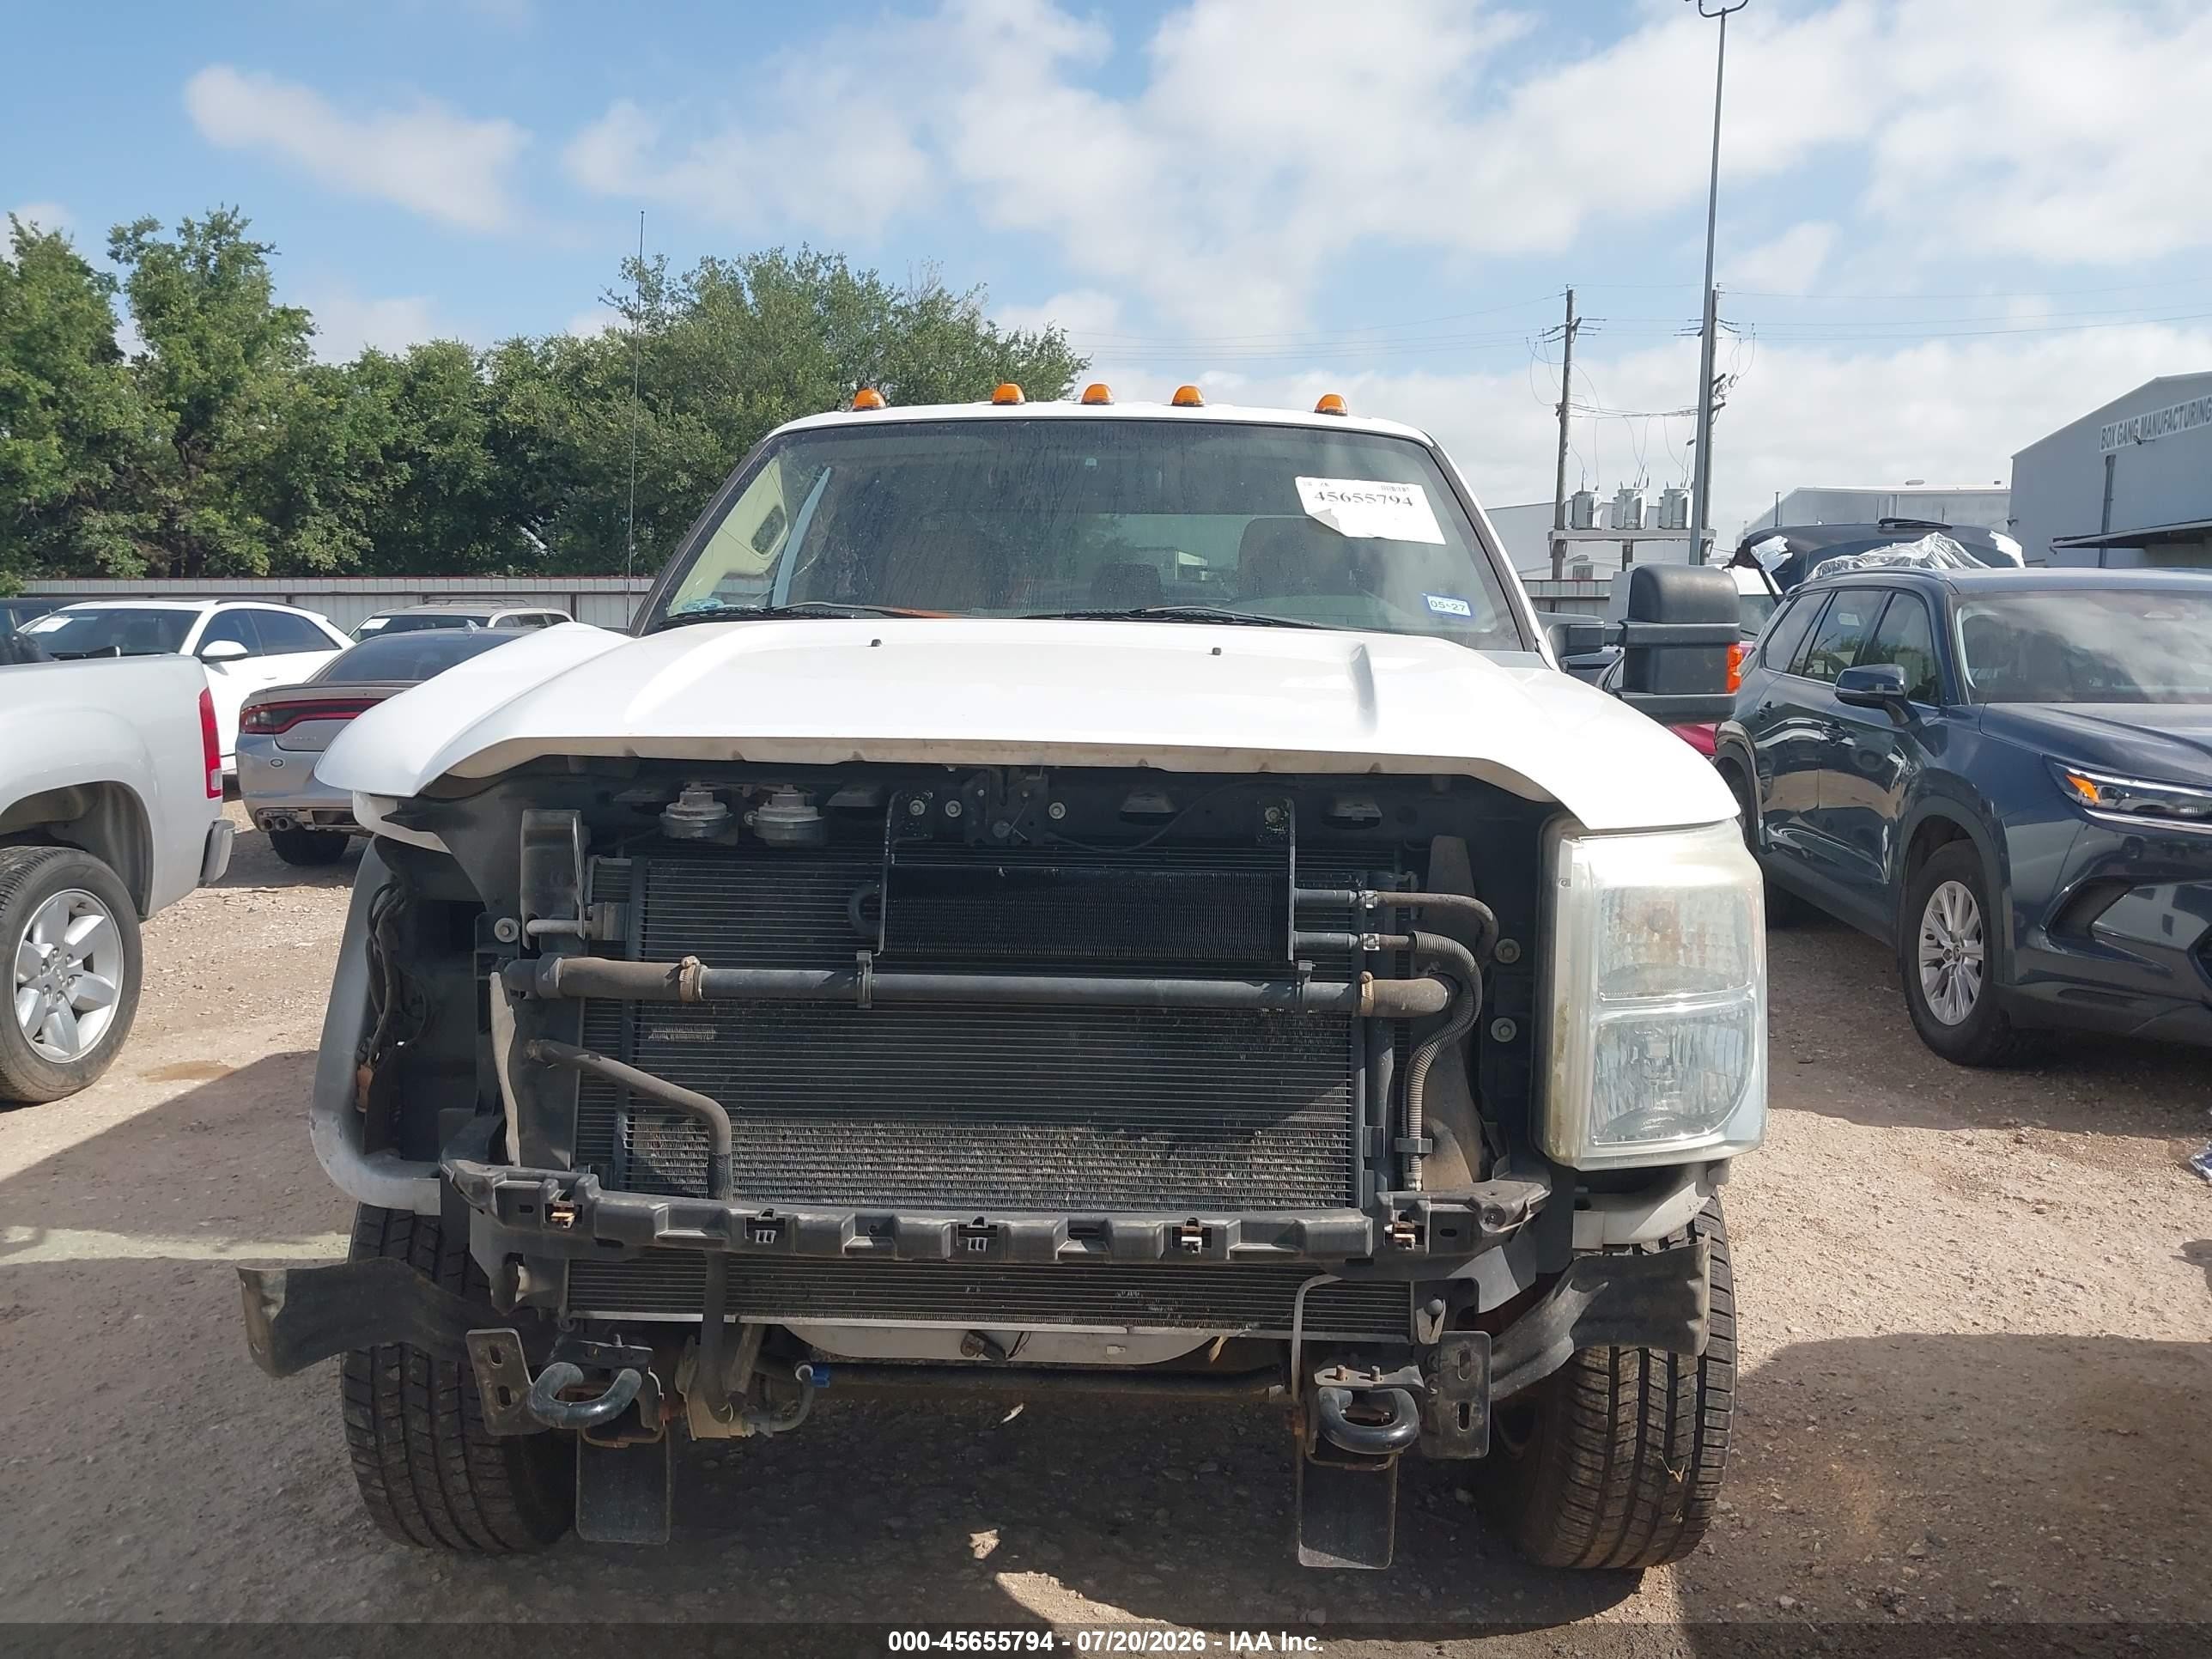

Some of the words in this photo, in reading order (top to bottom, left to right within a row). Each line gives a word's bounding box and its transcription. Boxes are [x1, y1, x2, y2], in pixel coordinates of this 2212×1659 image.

[2100, 425, 2117, 450] BOX
[2140, 397, 2212, 441] MANUFACTURING
[1314, 490, 1413, 507] 45655794
[1430, 599, 1466, 612] 05-27
